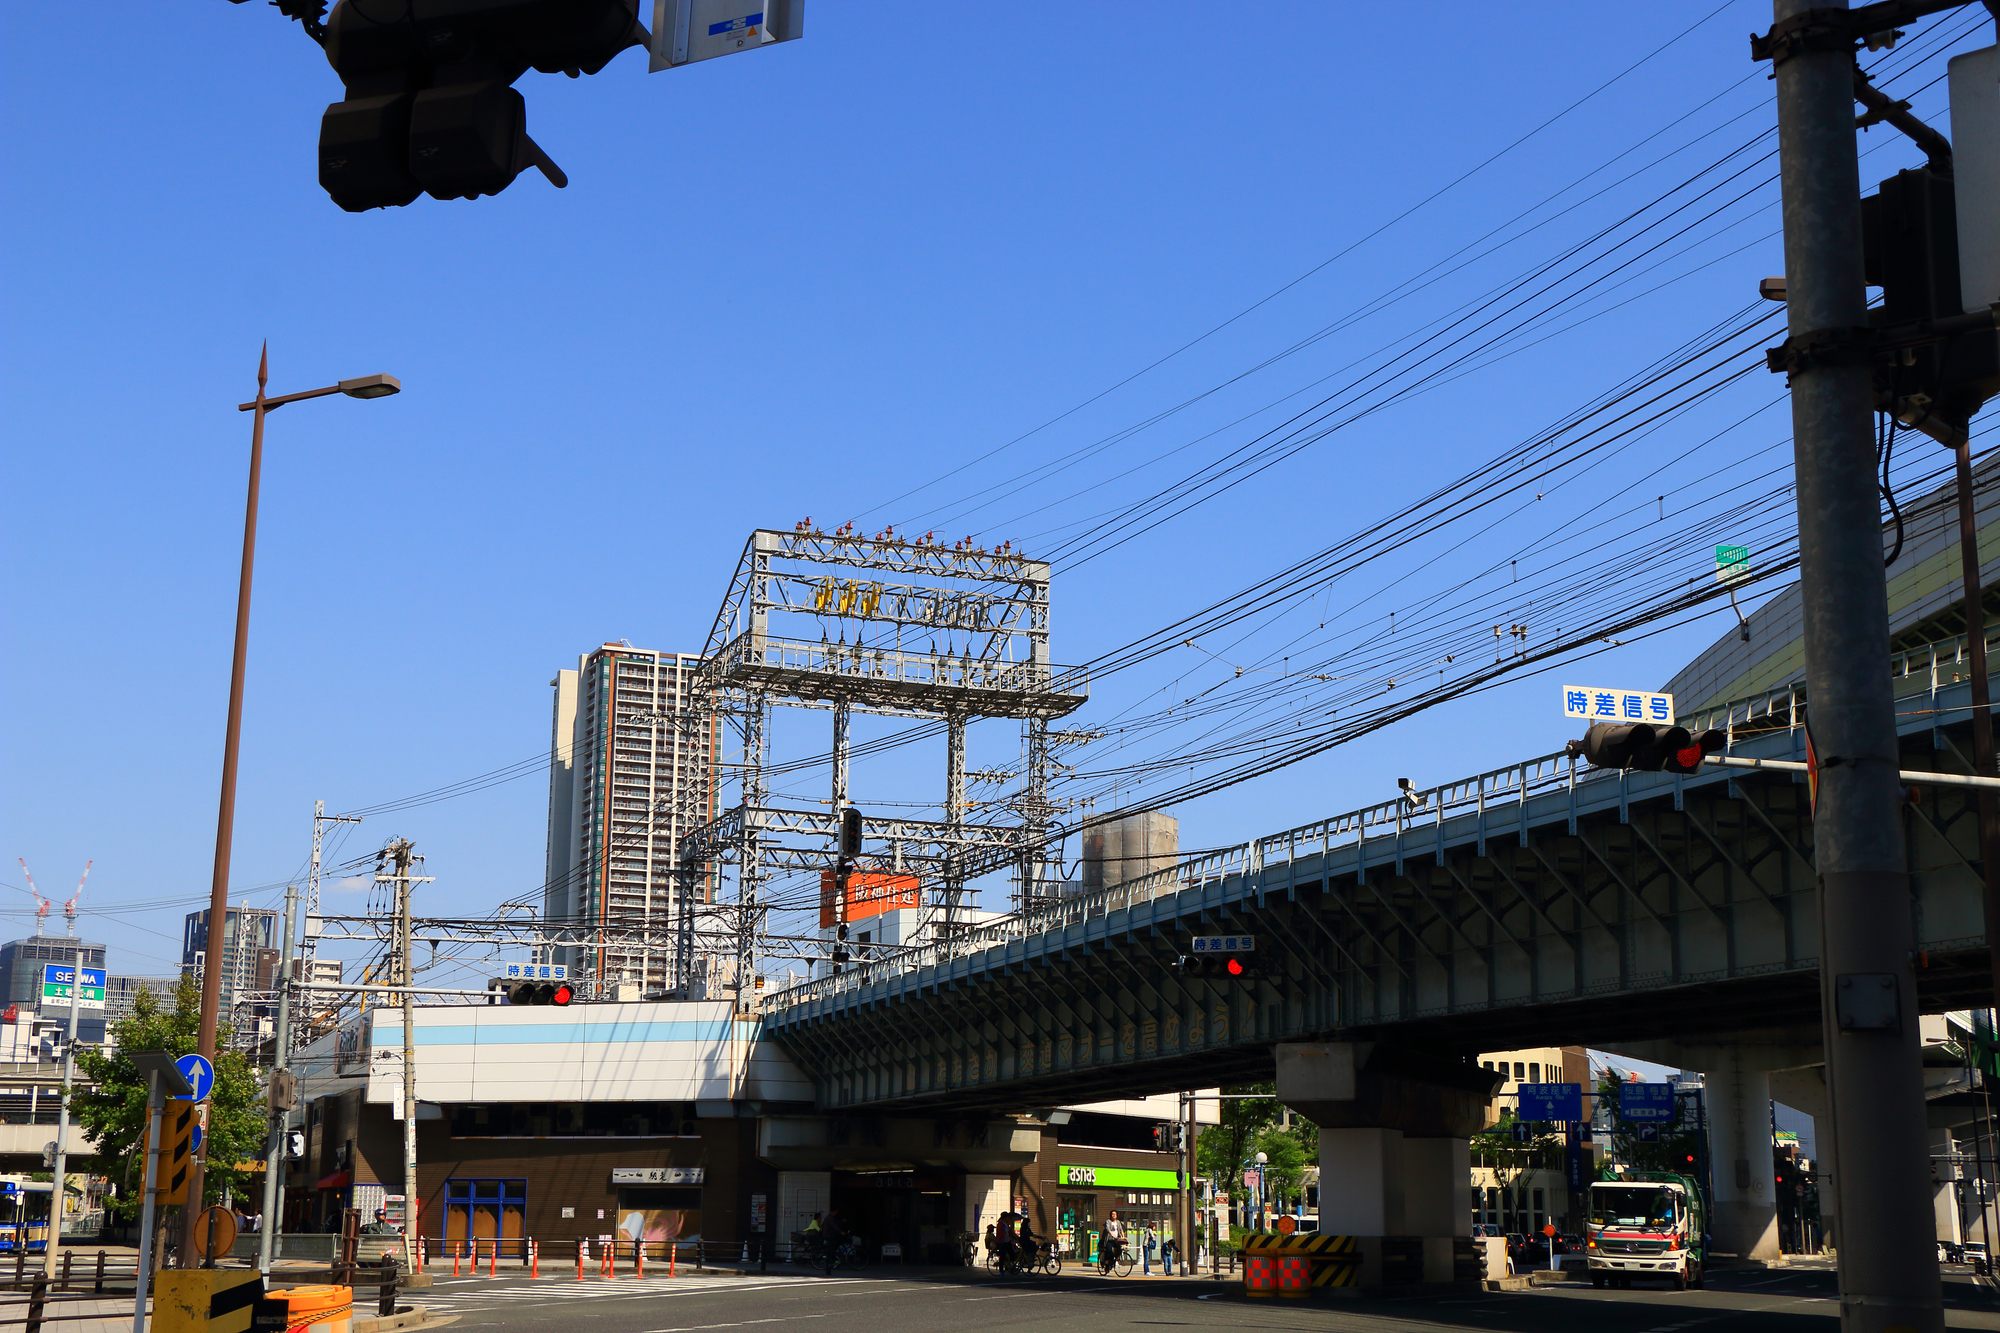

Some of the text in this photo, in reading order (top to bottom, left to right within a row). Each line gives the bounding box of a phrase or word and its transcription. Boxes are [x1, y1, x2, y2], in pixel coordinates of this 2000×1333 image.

[1567, 690, 1670, 720] 時差信号
[1194, 937, 1253, 950] 時差信号
[55, 971, 96, 984] SEWA
[507, 964, 566, 979] 時差信号
[1527, 1085, 1573, 1096] 阿波座駅
[1624, 1085, 1645, 1096] 桜島
[1070, 1167, 1097, 1183] asnas
